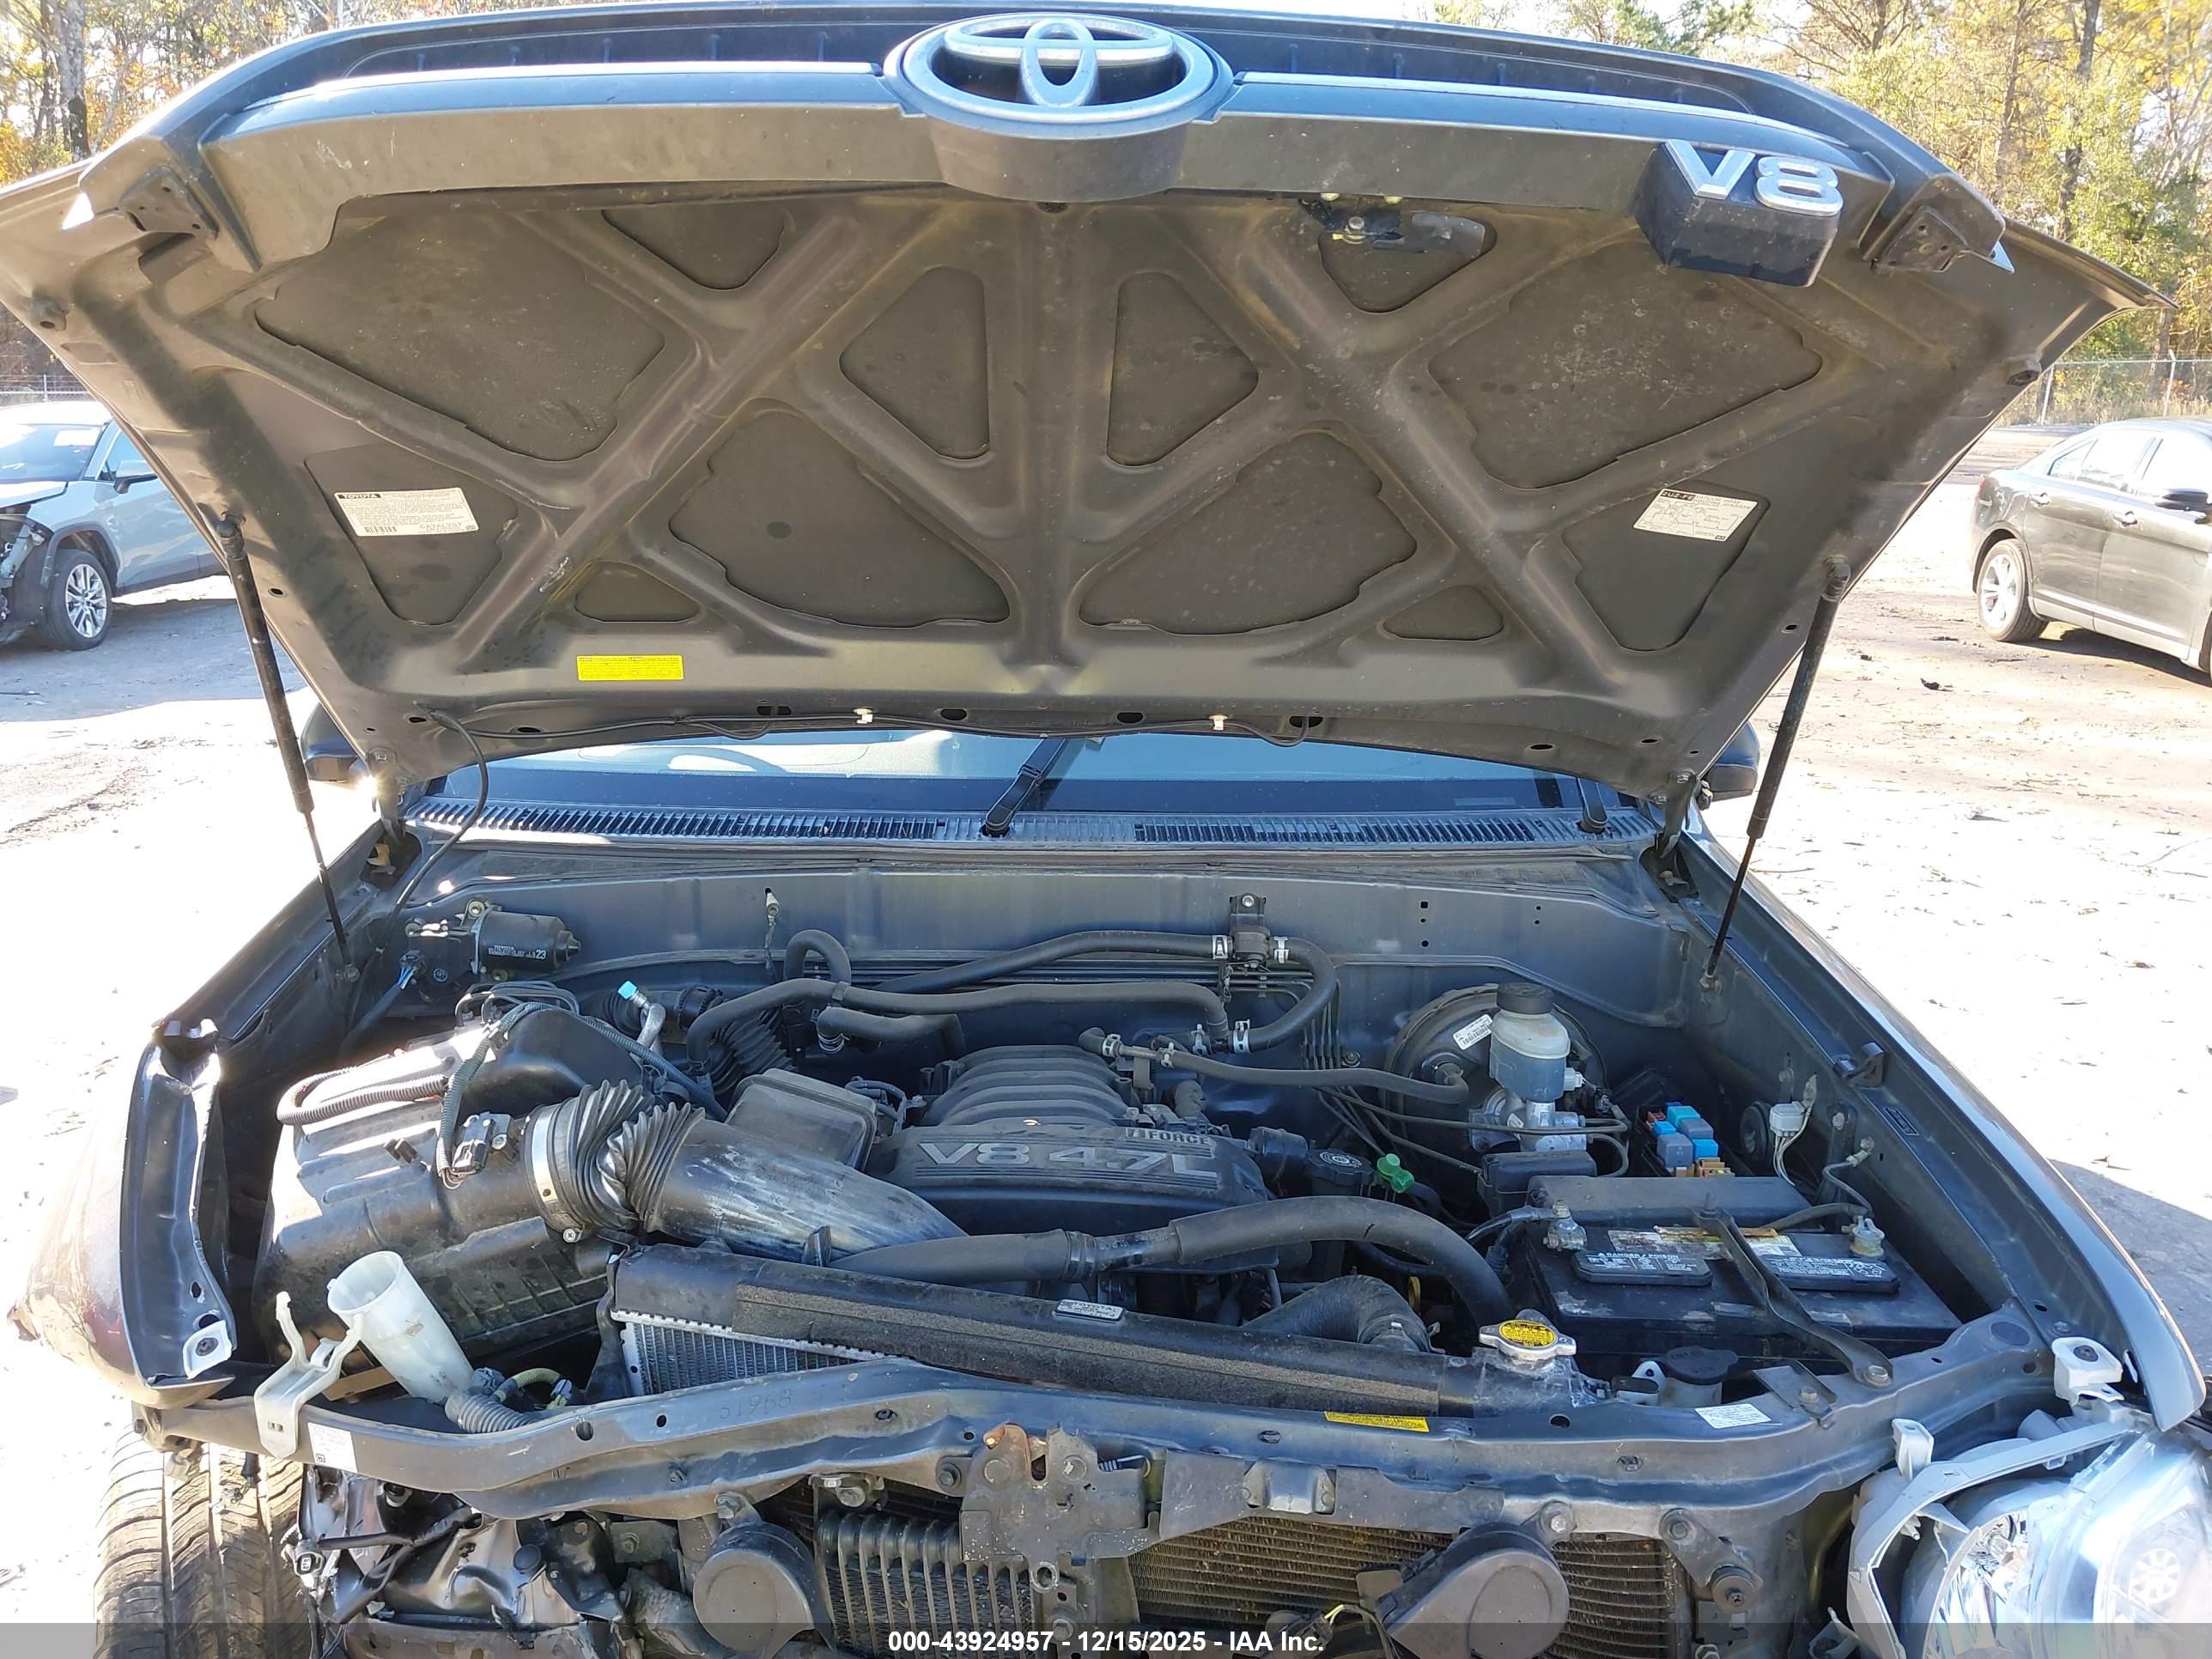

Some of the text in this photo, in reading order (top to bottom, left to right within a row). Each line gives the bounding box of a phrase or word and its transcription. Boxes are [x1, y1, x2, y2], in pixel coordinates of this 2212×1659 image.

[1665, 138, 1844, 216] V8
[535, 949, 547, 960] 23
[1148, 1130, 1210, 1146] FORCE
[918, 1142, 1218, 1177] V8 4.7L
